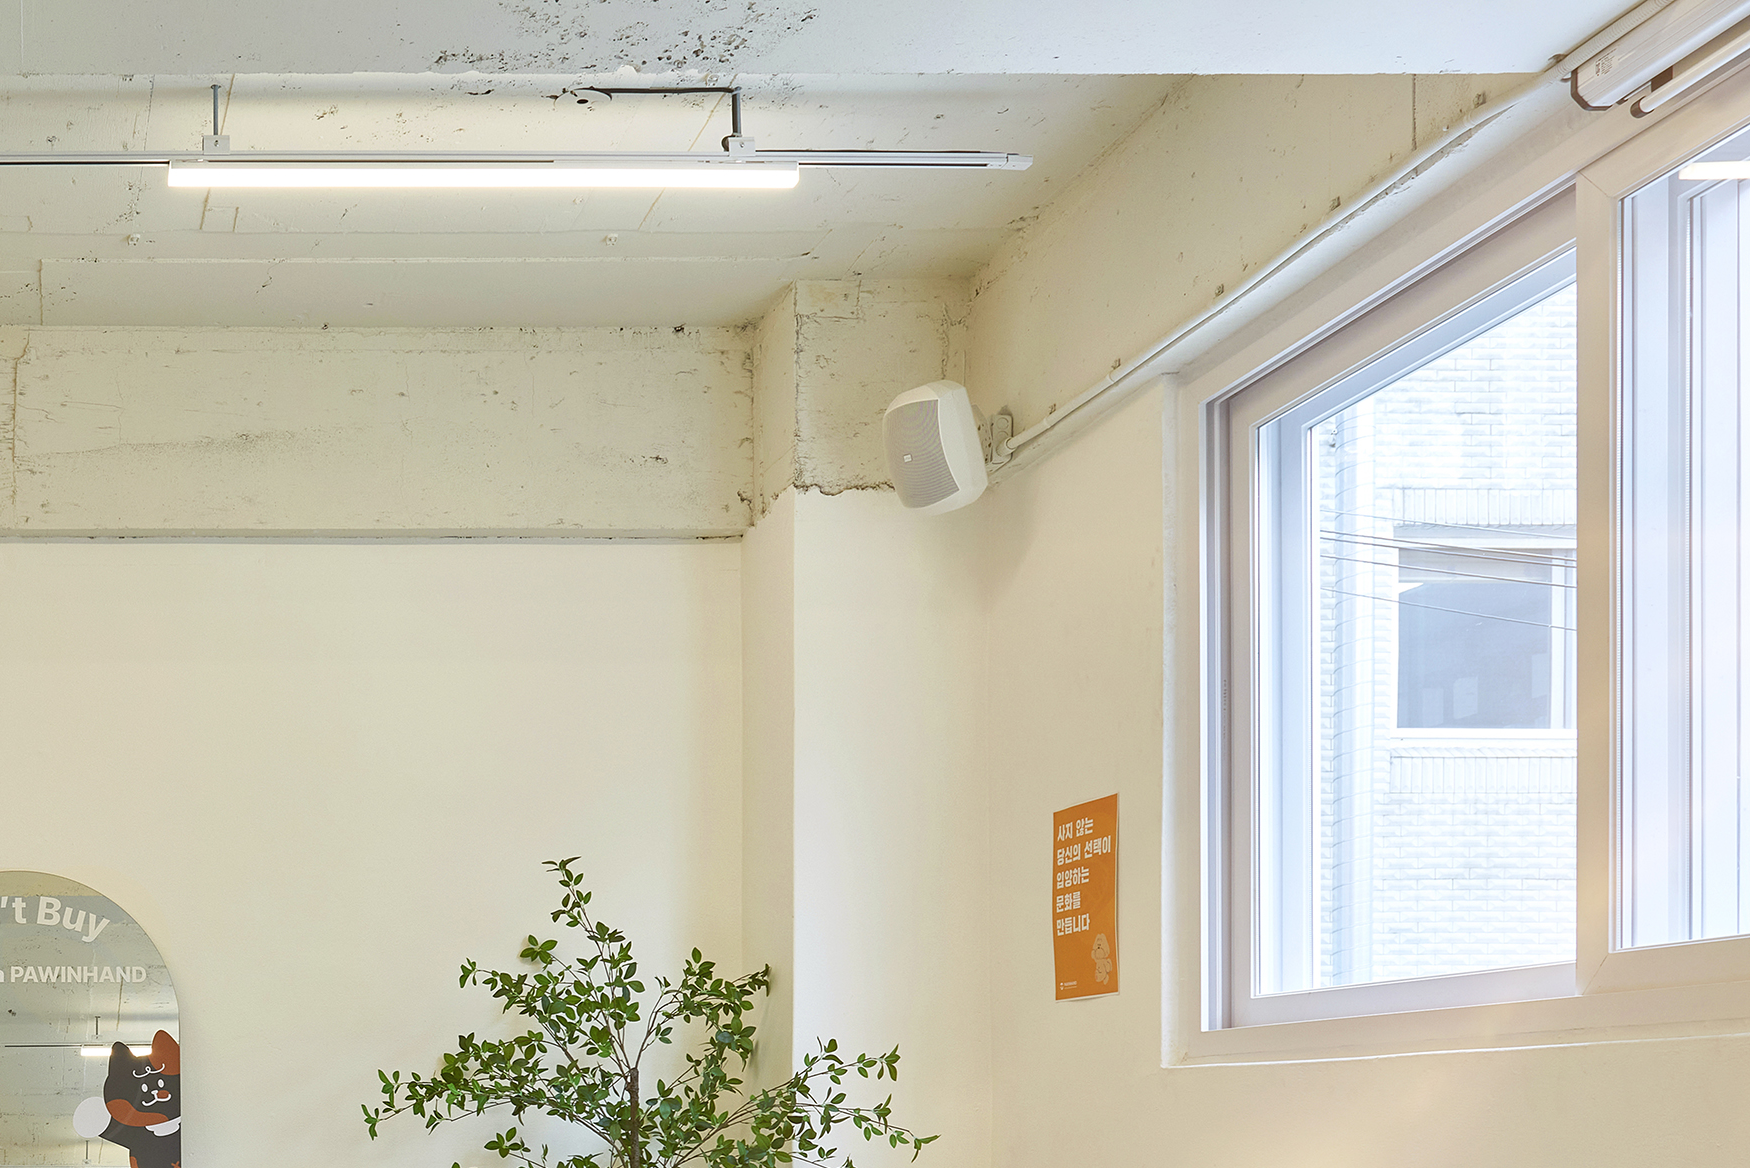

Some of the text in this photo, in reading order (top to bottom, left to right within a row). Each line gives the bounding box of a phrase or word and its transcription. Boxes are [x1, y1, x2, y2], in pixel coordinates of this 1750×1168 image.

[1057, 816, 1094, 842] 사지 않는
[1056, 835, 1111, 866] 당신의 선택이
[1056, 866, 1090, 890] 입양하는
[1056, 890, 1081, 913] 문화를
[36, 896, 110, 943] Buy
[1056, 913, 1090, 936] 만듭니다
[10, 966, 147, 983] PAWINHAND
